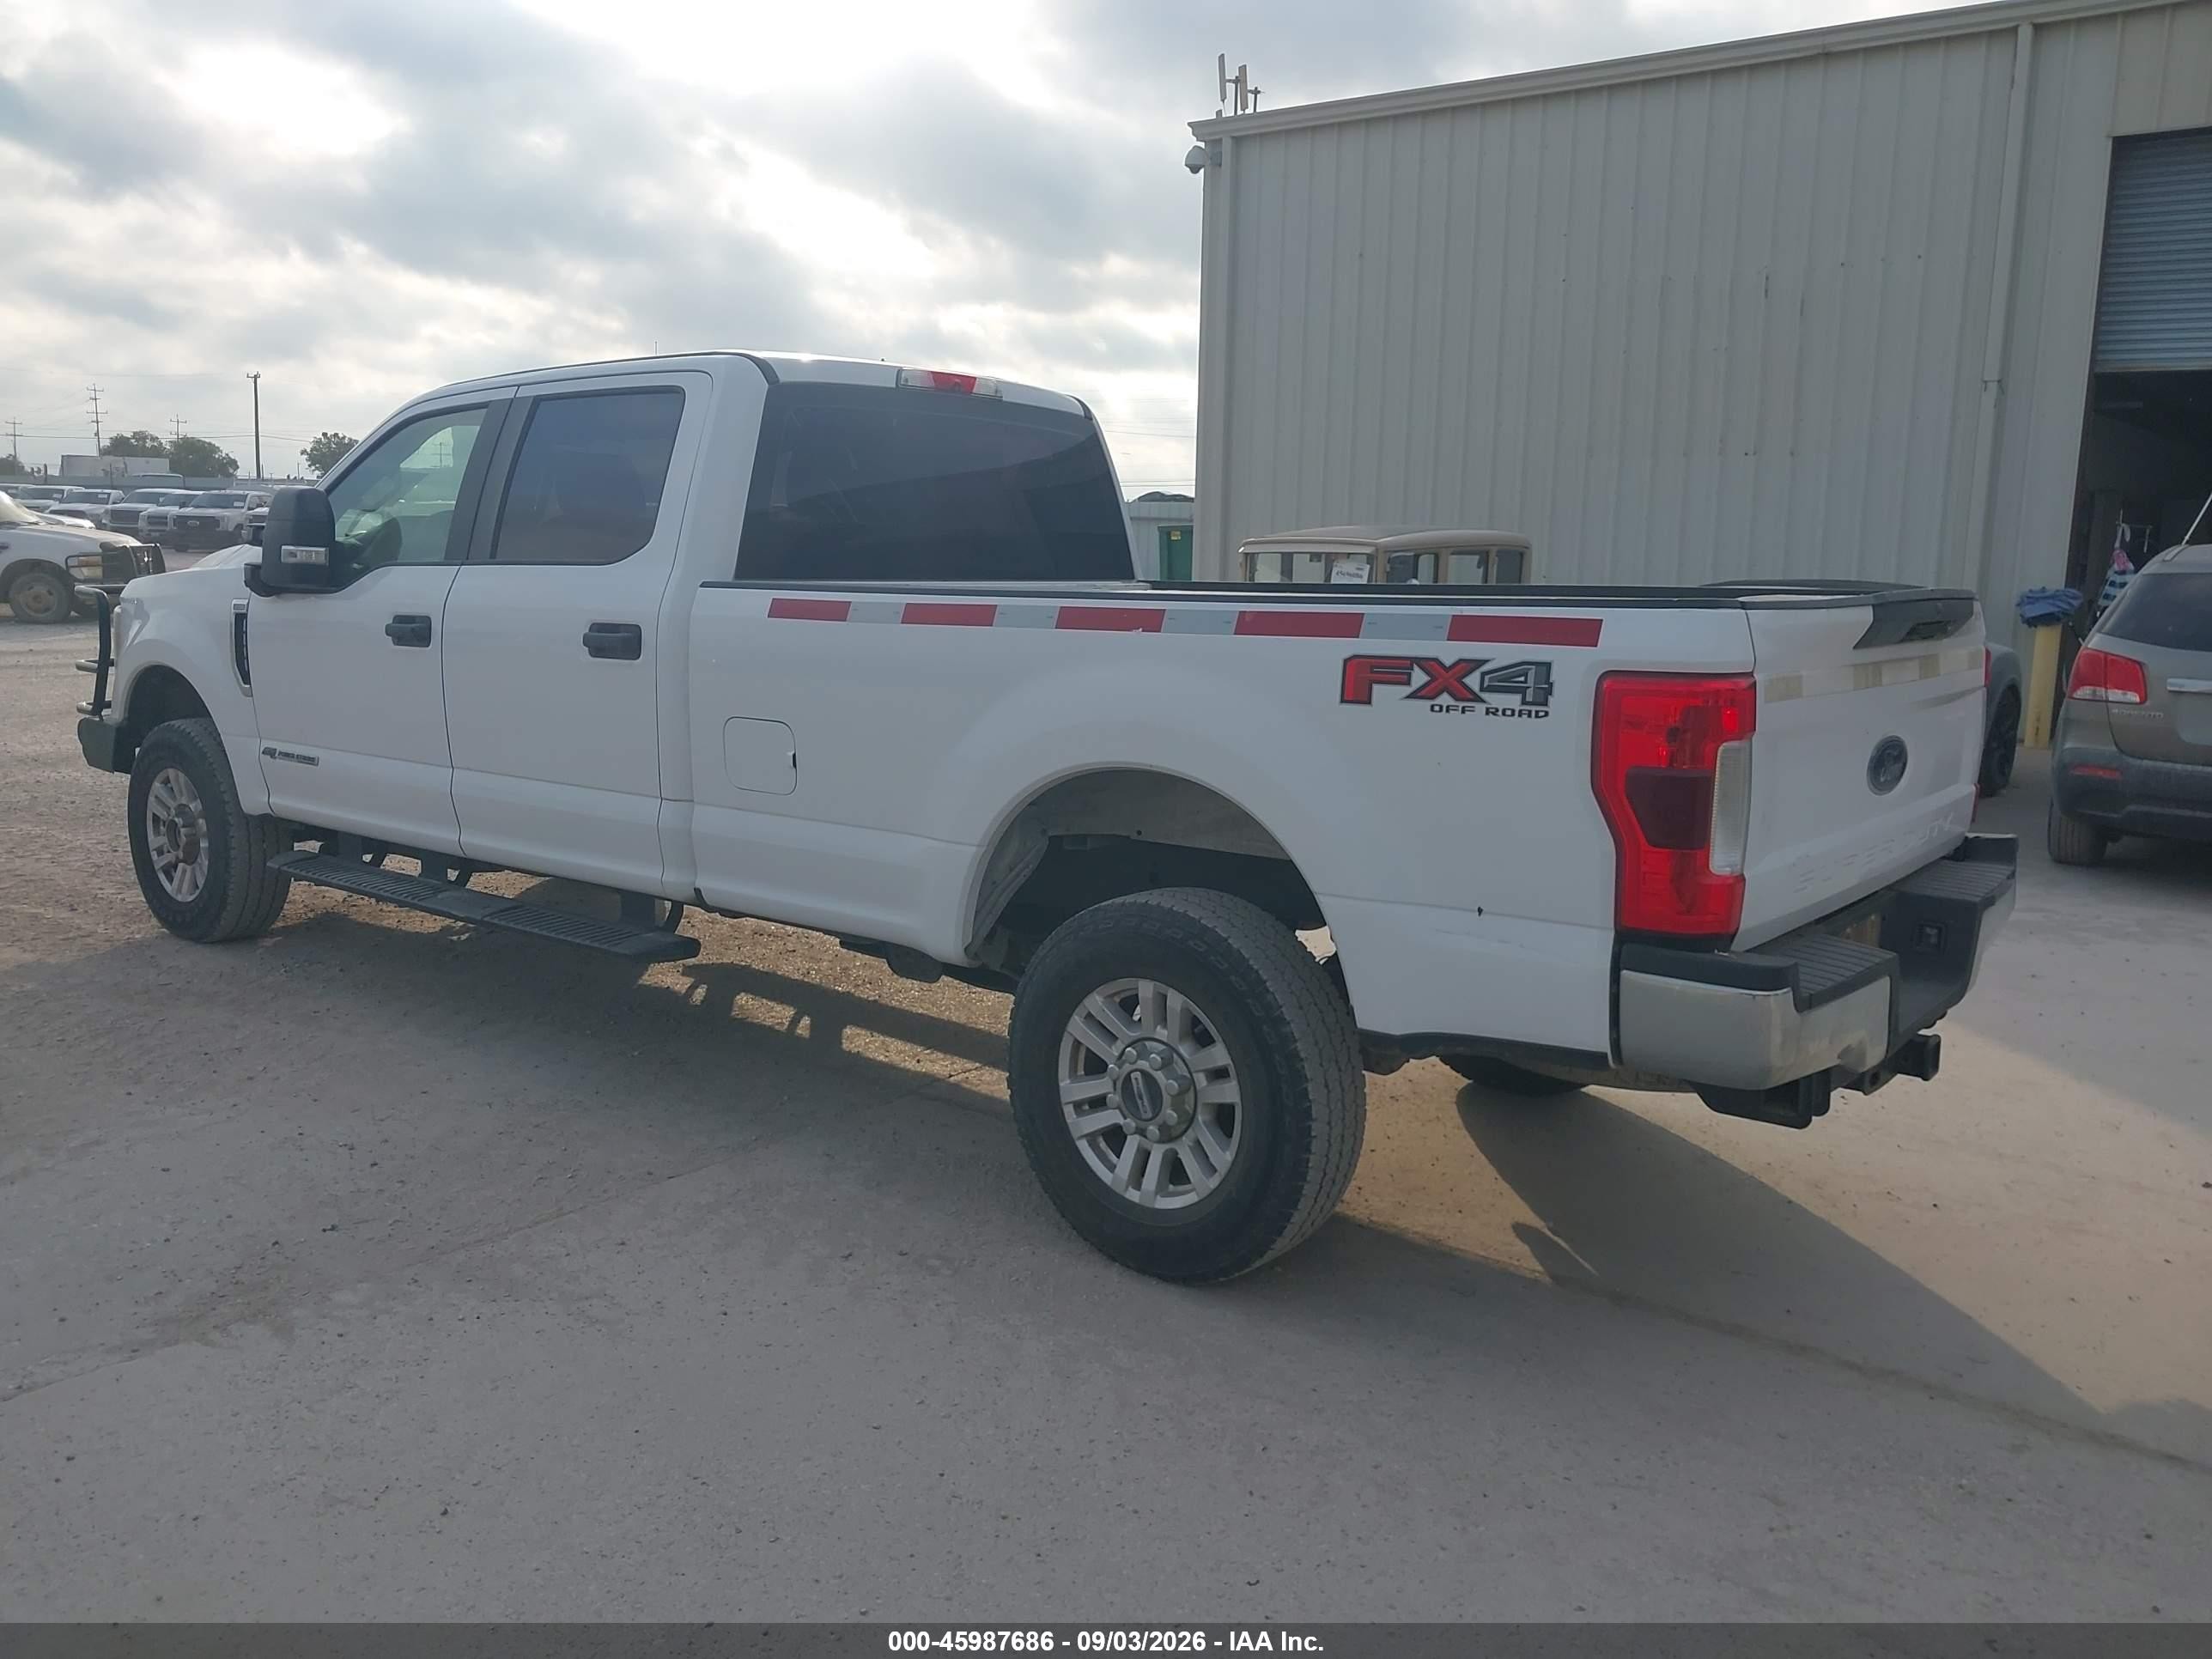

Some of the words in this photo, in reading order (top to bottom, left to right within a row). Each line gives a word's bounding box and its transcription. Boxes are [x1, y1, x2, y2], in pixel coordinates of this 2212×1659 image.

[1340, 654, 1554, 707] FX4
[1429, 703, 1476, 715] OFF
[1485, 706, 1550, 720] ROAD
